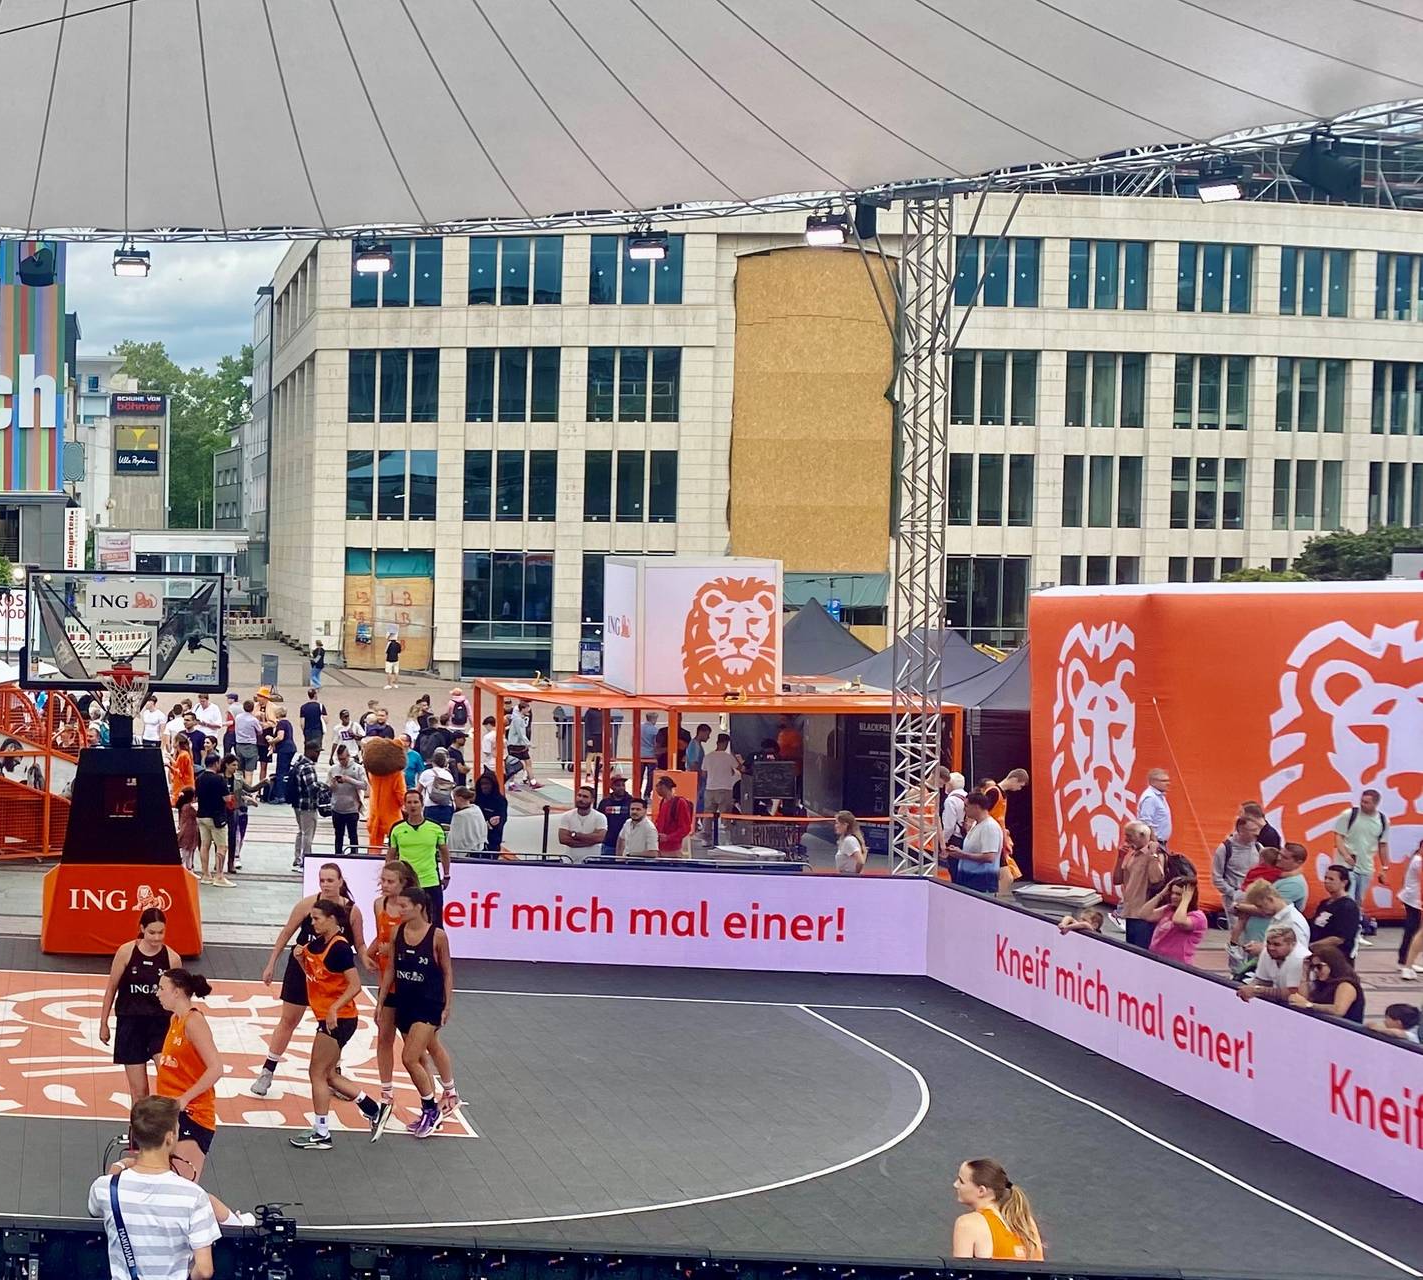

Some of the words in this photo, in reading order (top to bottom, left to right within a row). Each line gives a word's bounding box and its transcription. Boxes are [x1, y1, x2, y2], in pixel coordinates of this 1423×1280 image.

[116, 402, 161, 411] böhmer
[91, 594, 129, 609] ING
[69, 889, 128, 911] ING
[442, 892, 500, 930] eif
[513, 895, 614, 933] mich
[630, 900, 709, 938] mal
[724, 903, 845, 943] einer!
[397, 970, 411, 980] ING
[130, 984, 150, 994] ING
[996, 934, 1051, 989] Kneif
[1056, 960, 1110, 1015] mich
[1118, 992, 1164, 1042] mal
[1171, 1006, 1254, 1078] einer!
